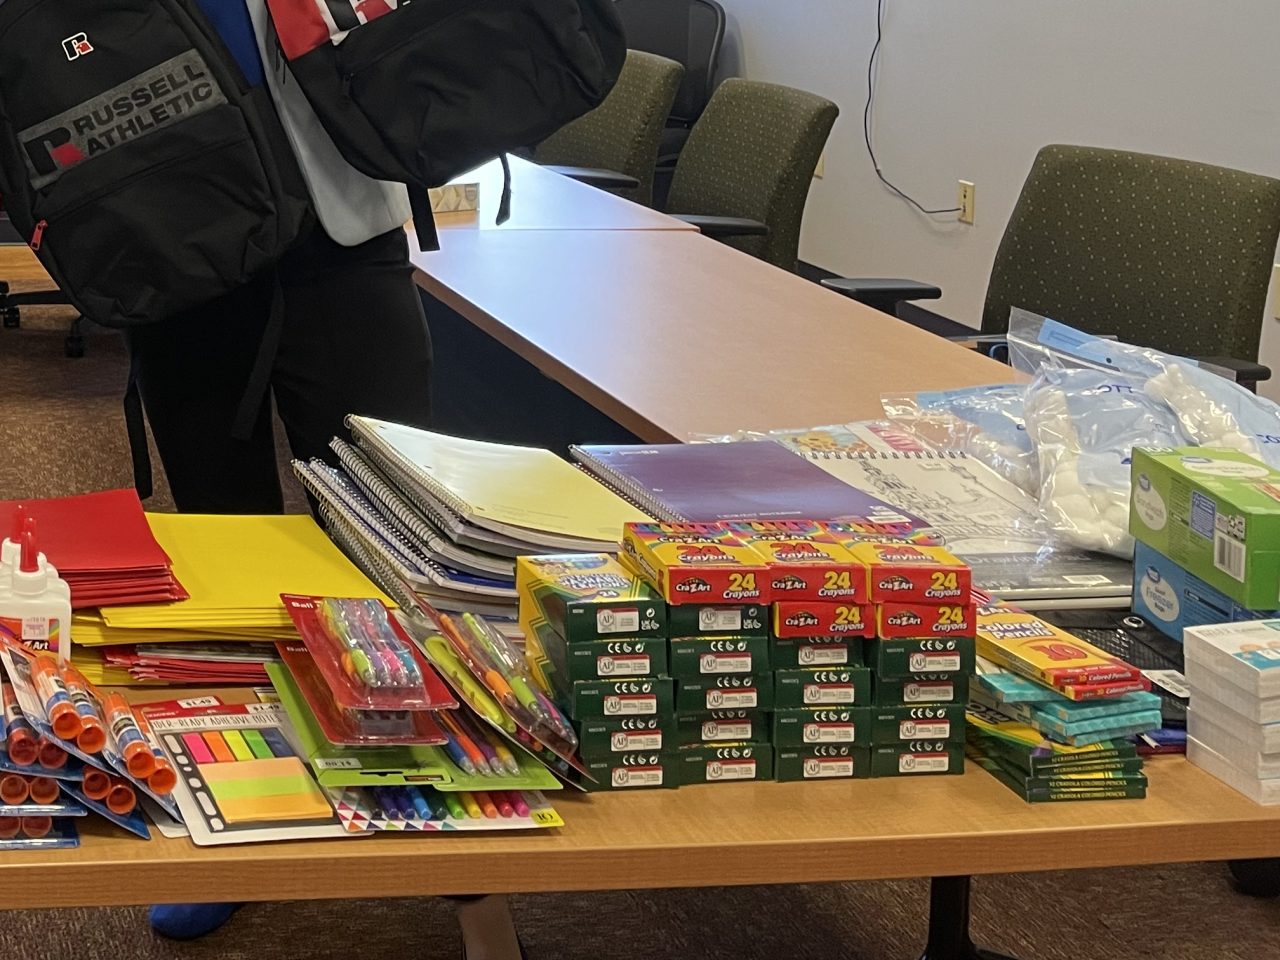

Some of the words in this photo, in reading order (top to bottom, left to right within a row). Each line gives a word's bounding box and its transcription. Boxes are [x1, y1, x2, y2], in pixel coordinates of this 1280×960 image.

[73, 64, 206, 137] RUSSELL
[87, 82, 213, 157] ATHLETIC
[678, 553, 735, 562] Crayons
[772, 551, 830, 560] Crayons
[728, 573, 757, 591] 24
[824, 571, 851, 590] 24
[930, 571, 959, 590] 24
[723, 589, 759, 600] Crayons
[818, 587, 855, 598] Crayons
[924, 588, 961, 598] Crayons
[834, 606, 861, 625] 24
[937, 606, 964, 625] 24
[829, 623, 865, 632] Crayons
[931, 623, 968, 632] Crayons
[976, 620, 1046, 633] Colored
[995, 628, 1054, 640] Pencils
[1031, 643, 1088, 661] 10
[1089, 672, 1111, 681] Colored
[1111, 671, 1132, 679] Pencils
[210, 715, 250, 727] ADHESIVE
